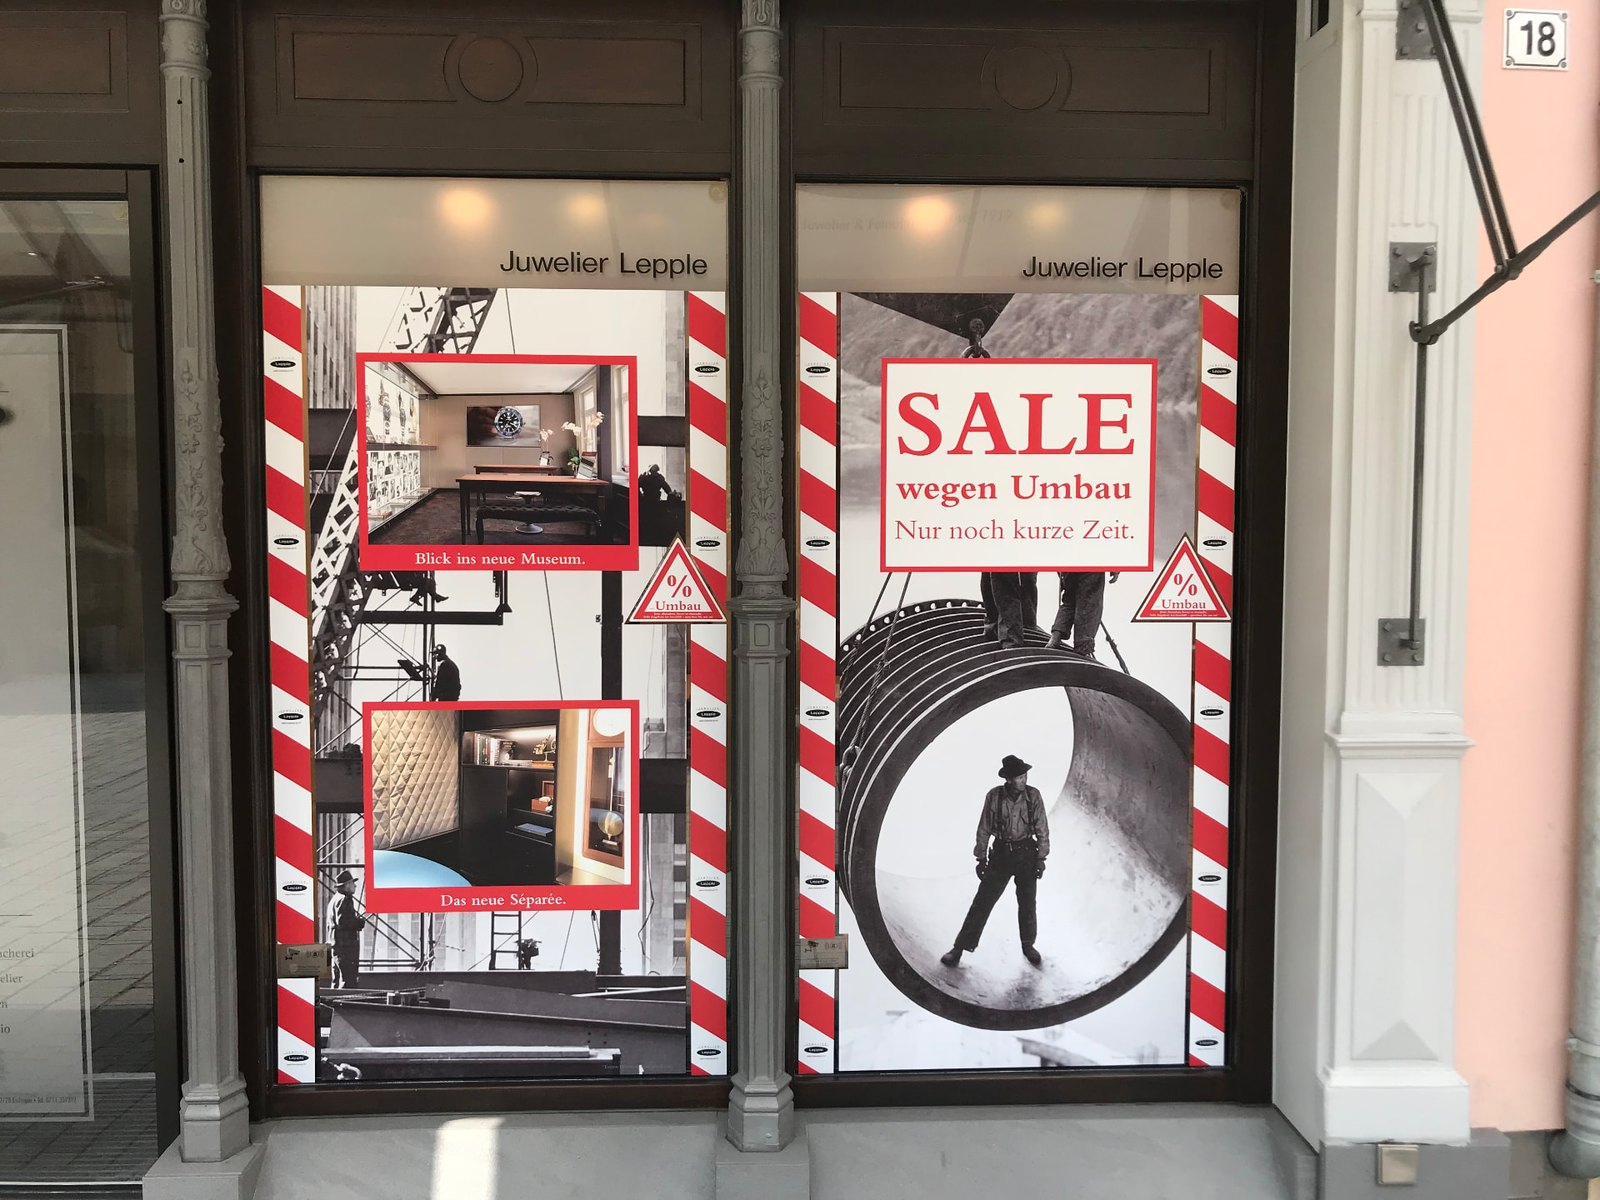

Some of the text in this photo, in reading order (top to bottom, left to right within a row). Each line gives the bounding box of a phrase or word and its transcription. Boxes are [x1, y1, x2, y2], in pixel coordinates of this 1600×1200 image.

[1521, 20, 1555, 57] 18
[500, 250, 708, 280] Juwelier Lepple
[1022, 256, 1223, 283] Juwelier Lepple
[897, 391, 1135, 457] SALE
[896, 473, 1132, 508] wegen Umbau
[895, 519, 1135, 540] Nur noch kurze Zeit.
[415, 552, 586, 565] Blick ins neue Museum.
[667, 575, 692, 598] %
[1174, 573, 1198, 597] %
[656, 600, 701, 611] Umbau
[1162, 599, 1206, 609] Umbau
[440, 892, 567, 909] Das neue Séparée.
